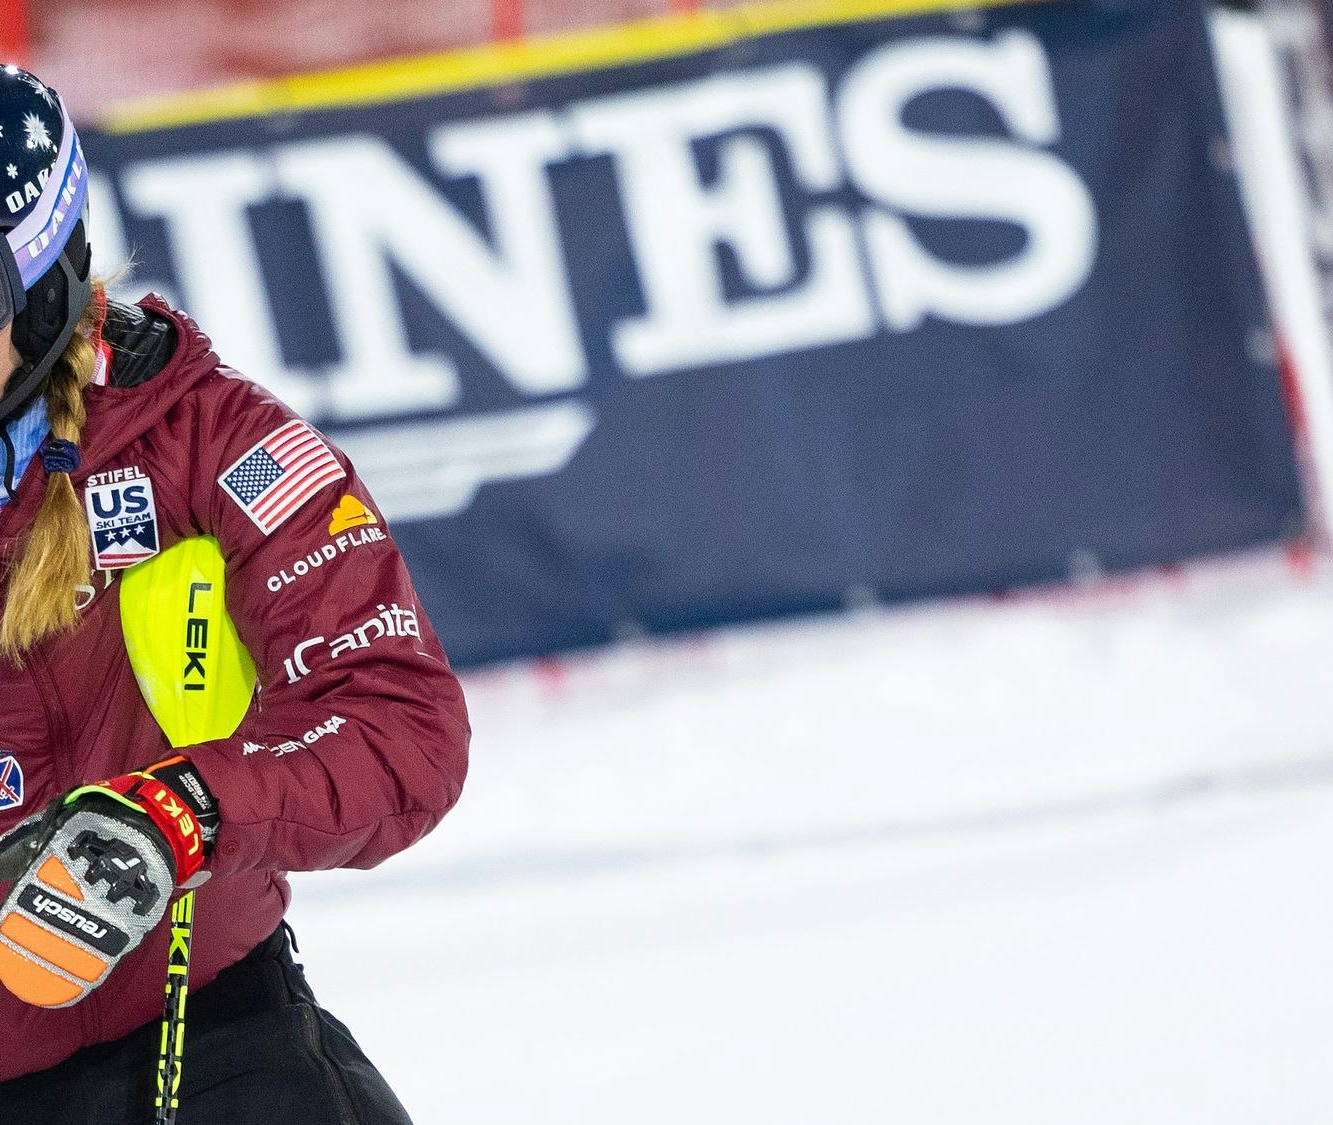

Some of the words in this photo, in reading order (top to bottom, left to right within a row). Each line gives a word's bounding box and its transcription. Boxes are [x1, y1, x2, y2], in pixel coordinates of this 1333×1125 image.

[5, 163, 58, 214] OAK
[87, 466, 146, 487] STIFEL
[91, 485, 148, 518] US
[96, 518, 117, 530] SKI
[119, 512, 151, 527] TEAM
[267, 527, 386, 593] CLOUDFLARE
[184, 582, 212, 691] LEKI
[283, 603, 422, 684] iCapita
[154, 790, 200, 856] LEKI
[32, 894, 108, 940] reusch
[167, 890, 194, 976] EKI
